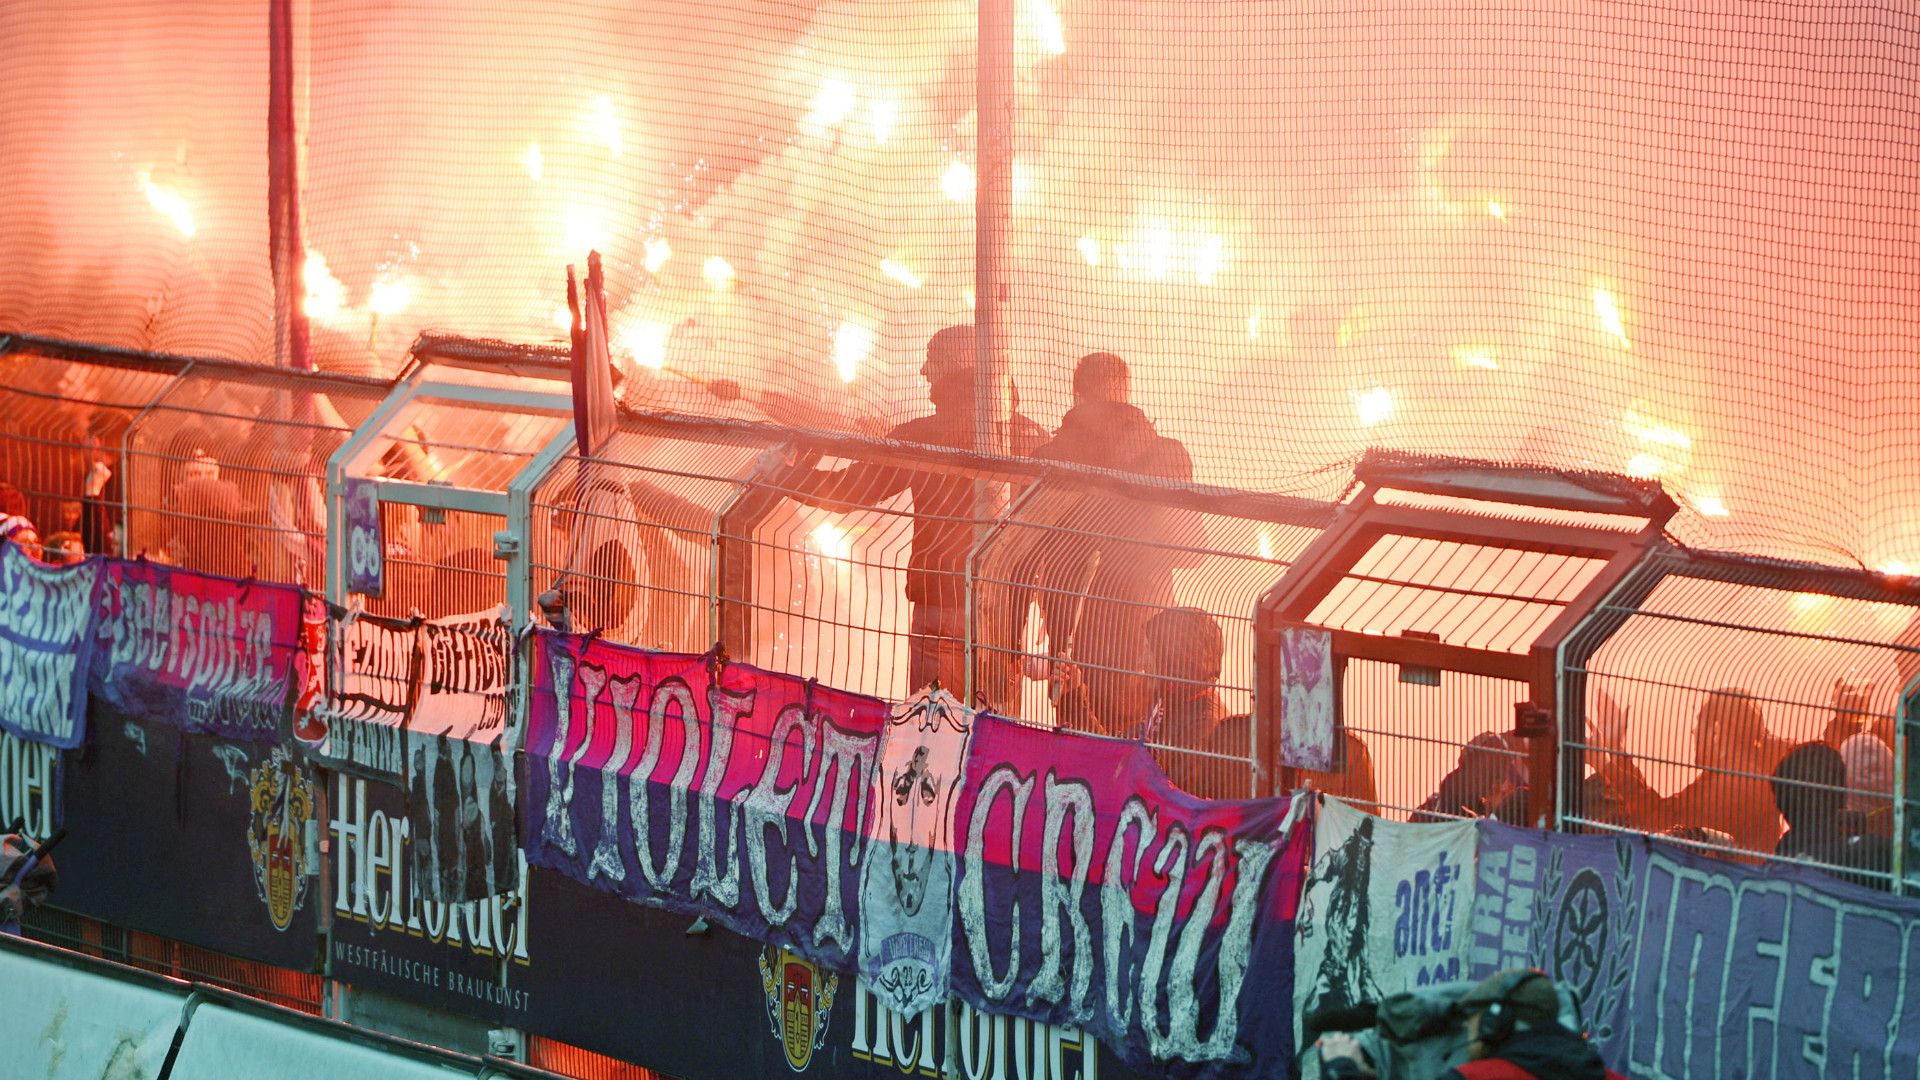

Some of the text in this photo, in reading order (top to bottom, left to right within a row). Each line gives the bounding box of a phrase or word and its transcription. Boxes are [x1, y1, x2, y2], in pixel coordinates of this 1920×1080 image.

[351, 526, 379, 576] 06
[330, 773, 530, 962] Herer
[541, 648, 1284, 1065] VIOLET CREW
[335, 941, 531, 1012] WESTFÄLISCHE BRAUKUNST
[1629, 852, 1920, 1080] INFER
